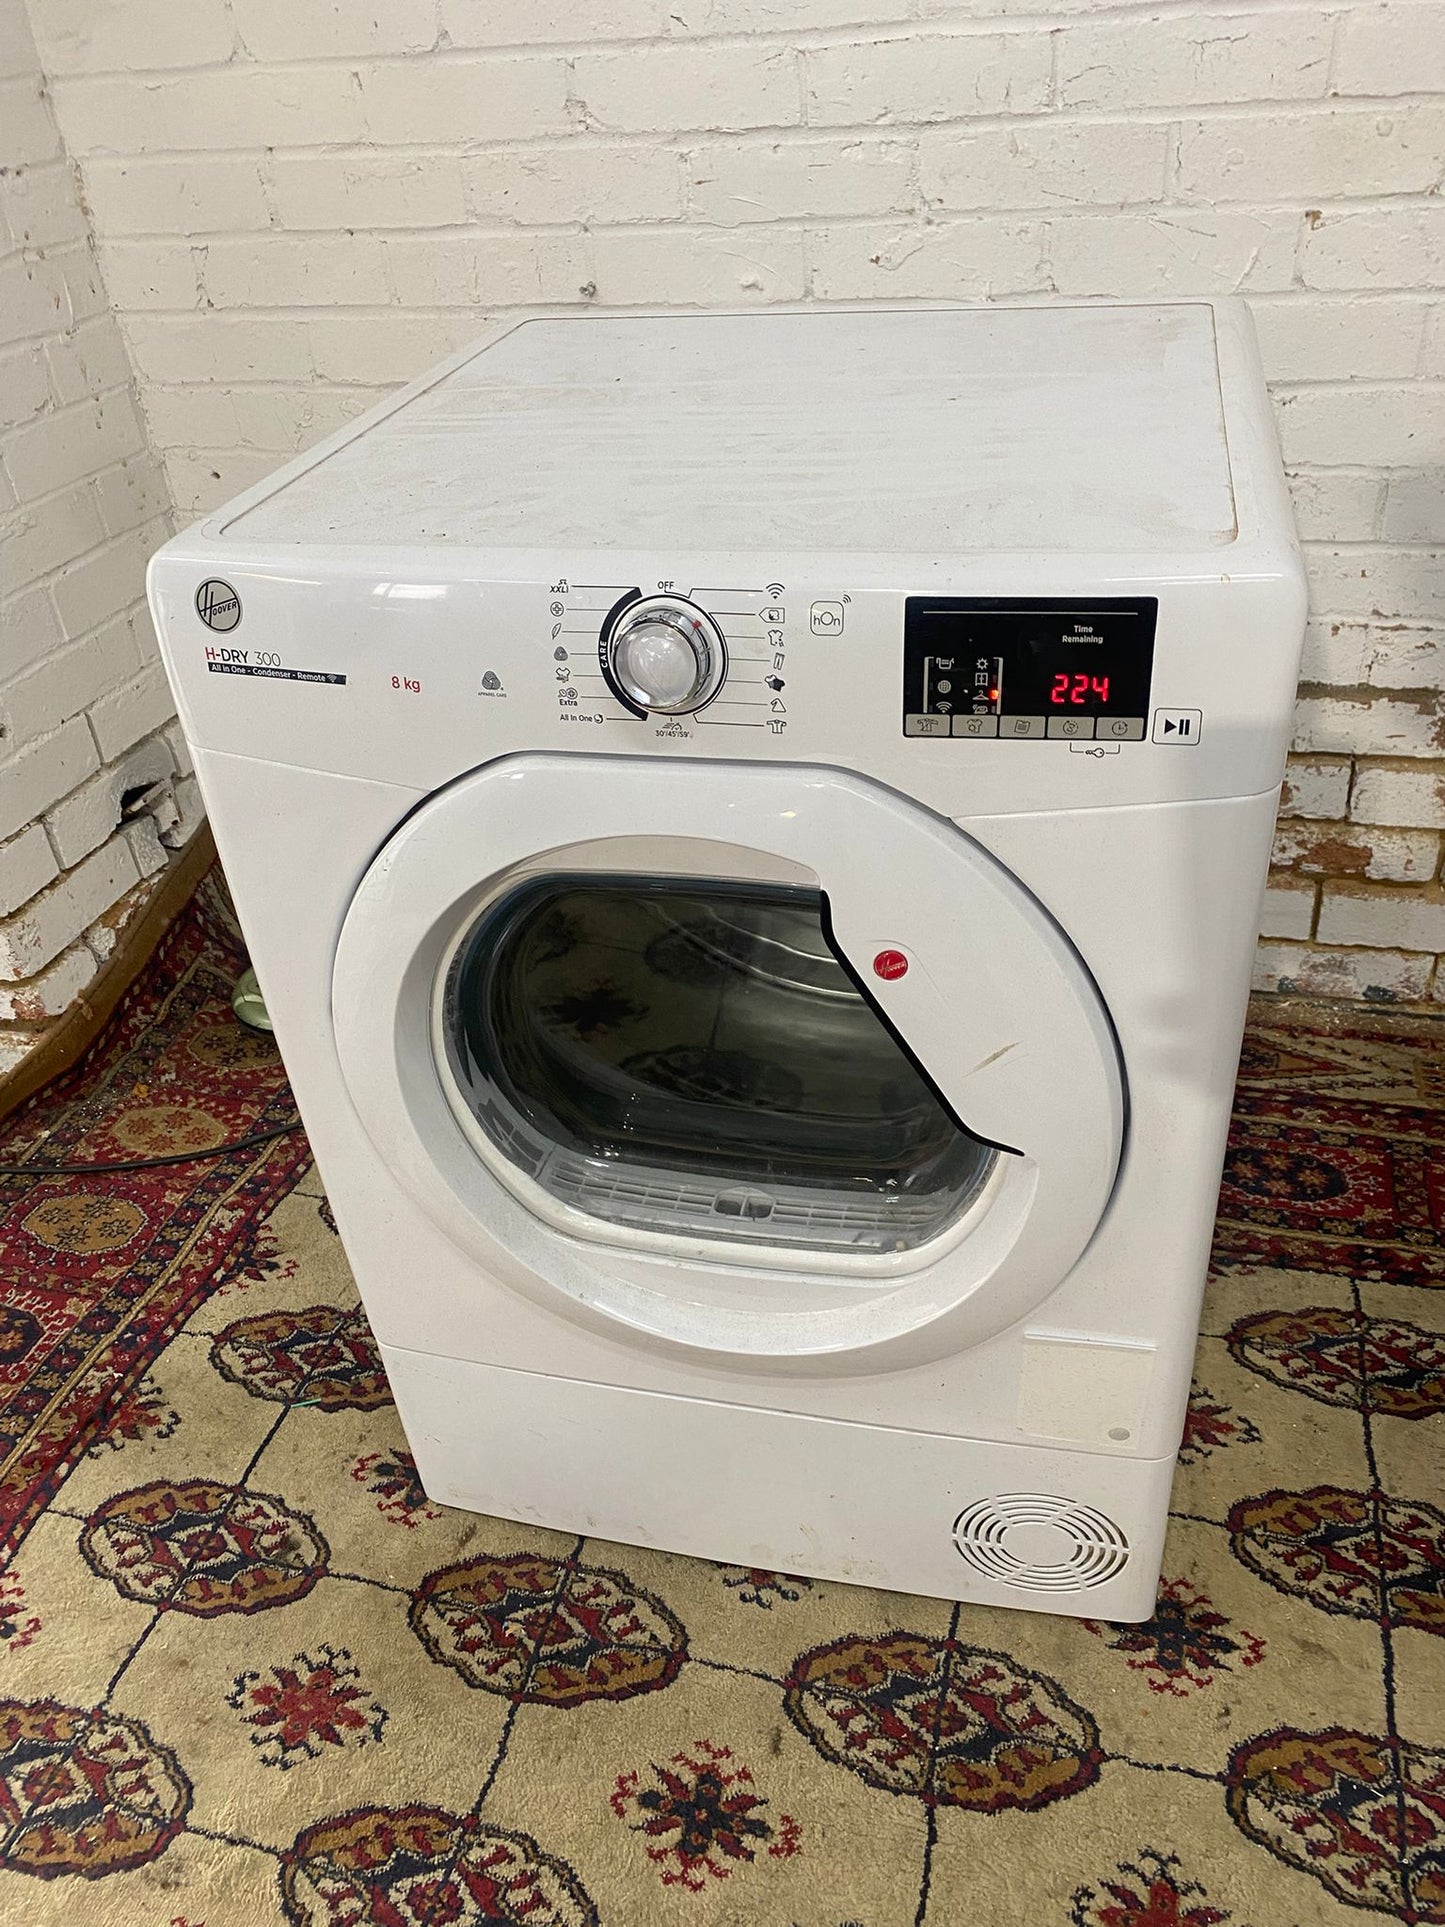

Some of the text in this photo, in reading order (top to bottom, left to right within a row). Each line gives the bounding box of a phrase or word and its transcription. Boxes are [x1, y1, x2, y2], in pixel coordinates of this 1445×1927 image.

[657, 581, 674, 590] OFF
[813, 611, 841, 626] hOn
[1074, 625, 1093, 633] Time
[1062, 635, 1104, 645] Remaining
[205, 647, 281, 667] H-DRY 300
[600, 641, 609, 668] CARE
[211, 663, 222, 672] All
[222, 664, 230, 673] In
[231, 665, 246, 674] One
[252, 668, 291, 679] Condenser
[297, 671, 326, 682] Remote
[391, 675, 421, 693] 8 kg
[1051, 674, 1109, 703] 224
